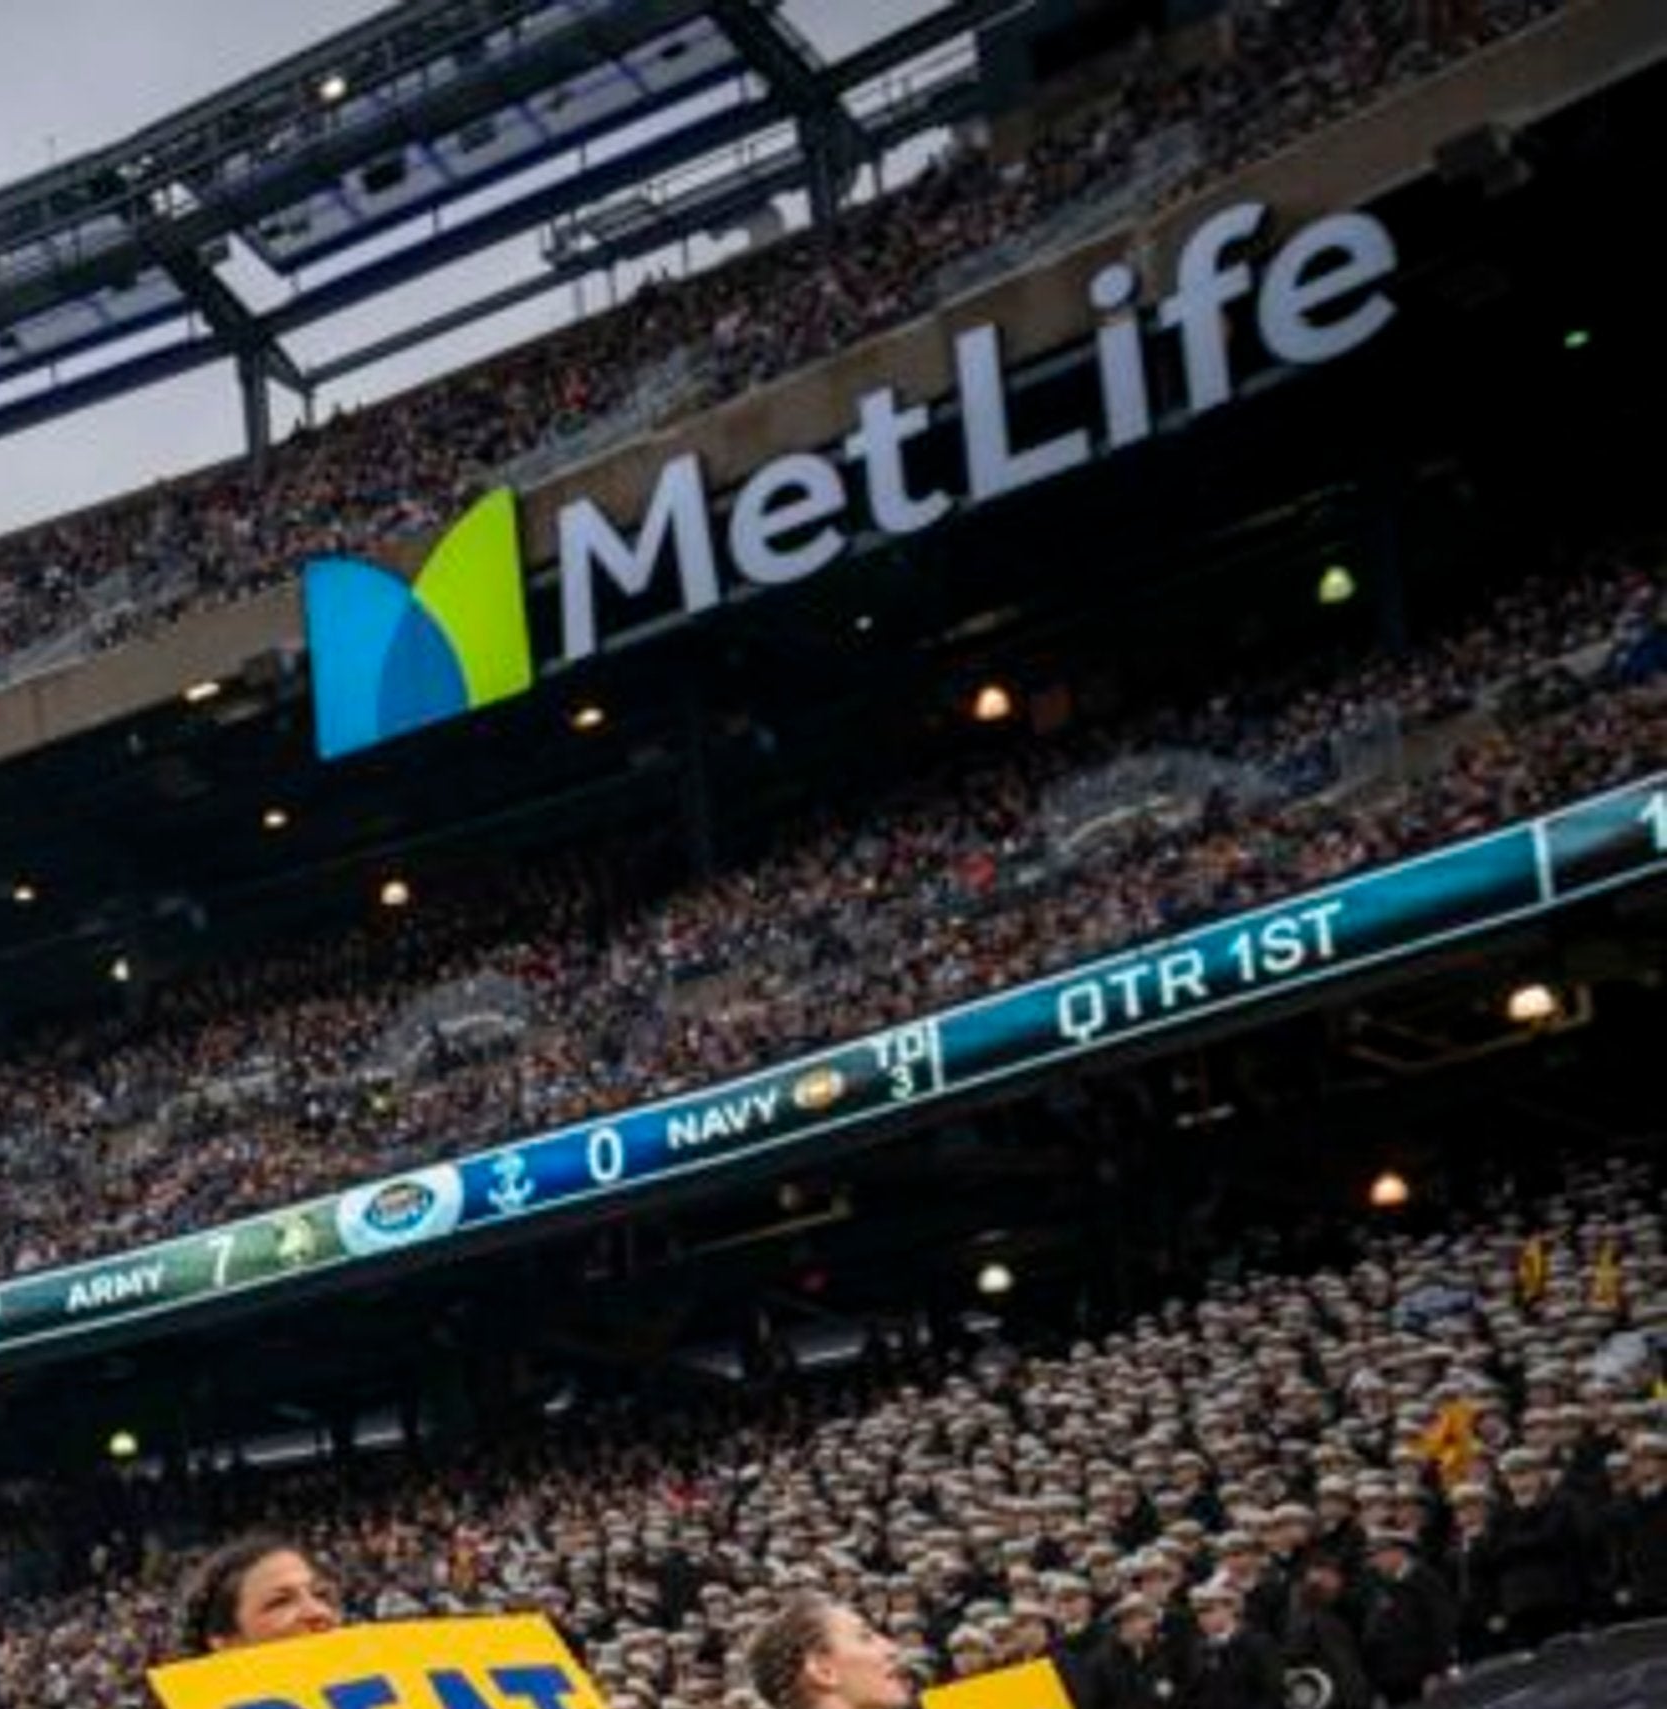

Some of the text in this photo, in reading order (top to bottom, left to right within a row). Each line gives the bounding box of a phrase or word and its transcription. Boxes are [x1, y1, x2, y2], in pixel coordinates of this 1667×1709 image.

[557, 201, 1397, 660] MetLife
[1057, 902, 1342, 1042] QTR 1ST
[890, 1066, 914, 1098] 3
[588, 1090, 778, 1182] 0 NAVY
[66, 1235, 235, 1313] ARMY 7
